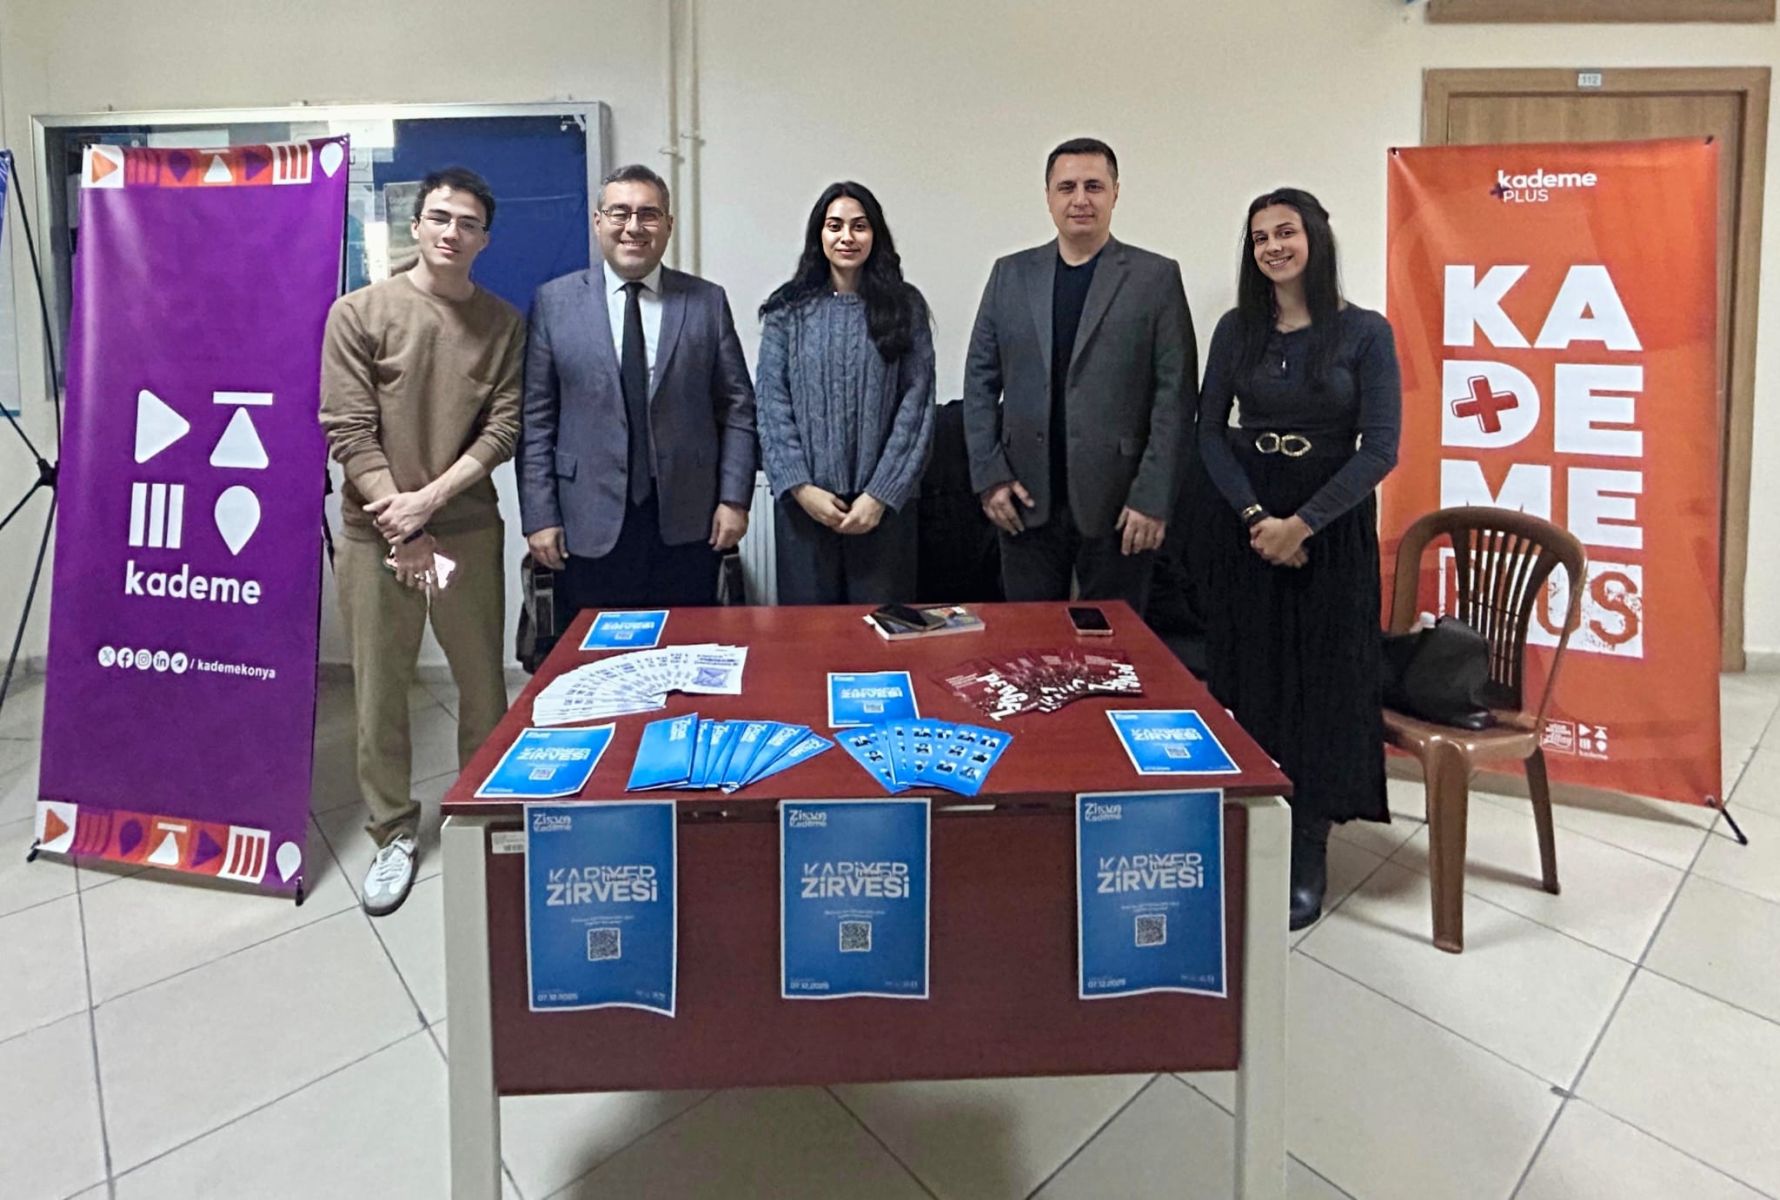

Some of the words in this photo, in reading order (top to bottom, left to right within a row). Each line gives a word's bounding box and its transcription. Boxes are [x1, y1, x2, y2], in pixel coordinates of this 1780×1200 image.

[1497, 168, 1597, 190] kademe
[1503, 189, 1549, 203] PLUS
[1442, 264, 1643, 351] KA
[1441, 359, 1643, 458] DE
[1440, 458, 1643, 550] ME
[125, 560, 262, 605] kademe
[197, 659, 276, 680] kademekonya
